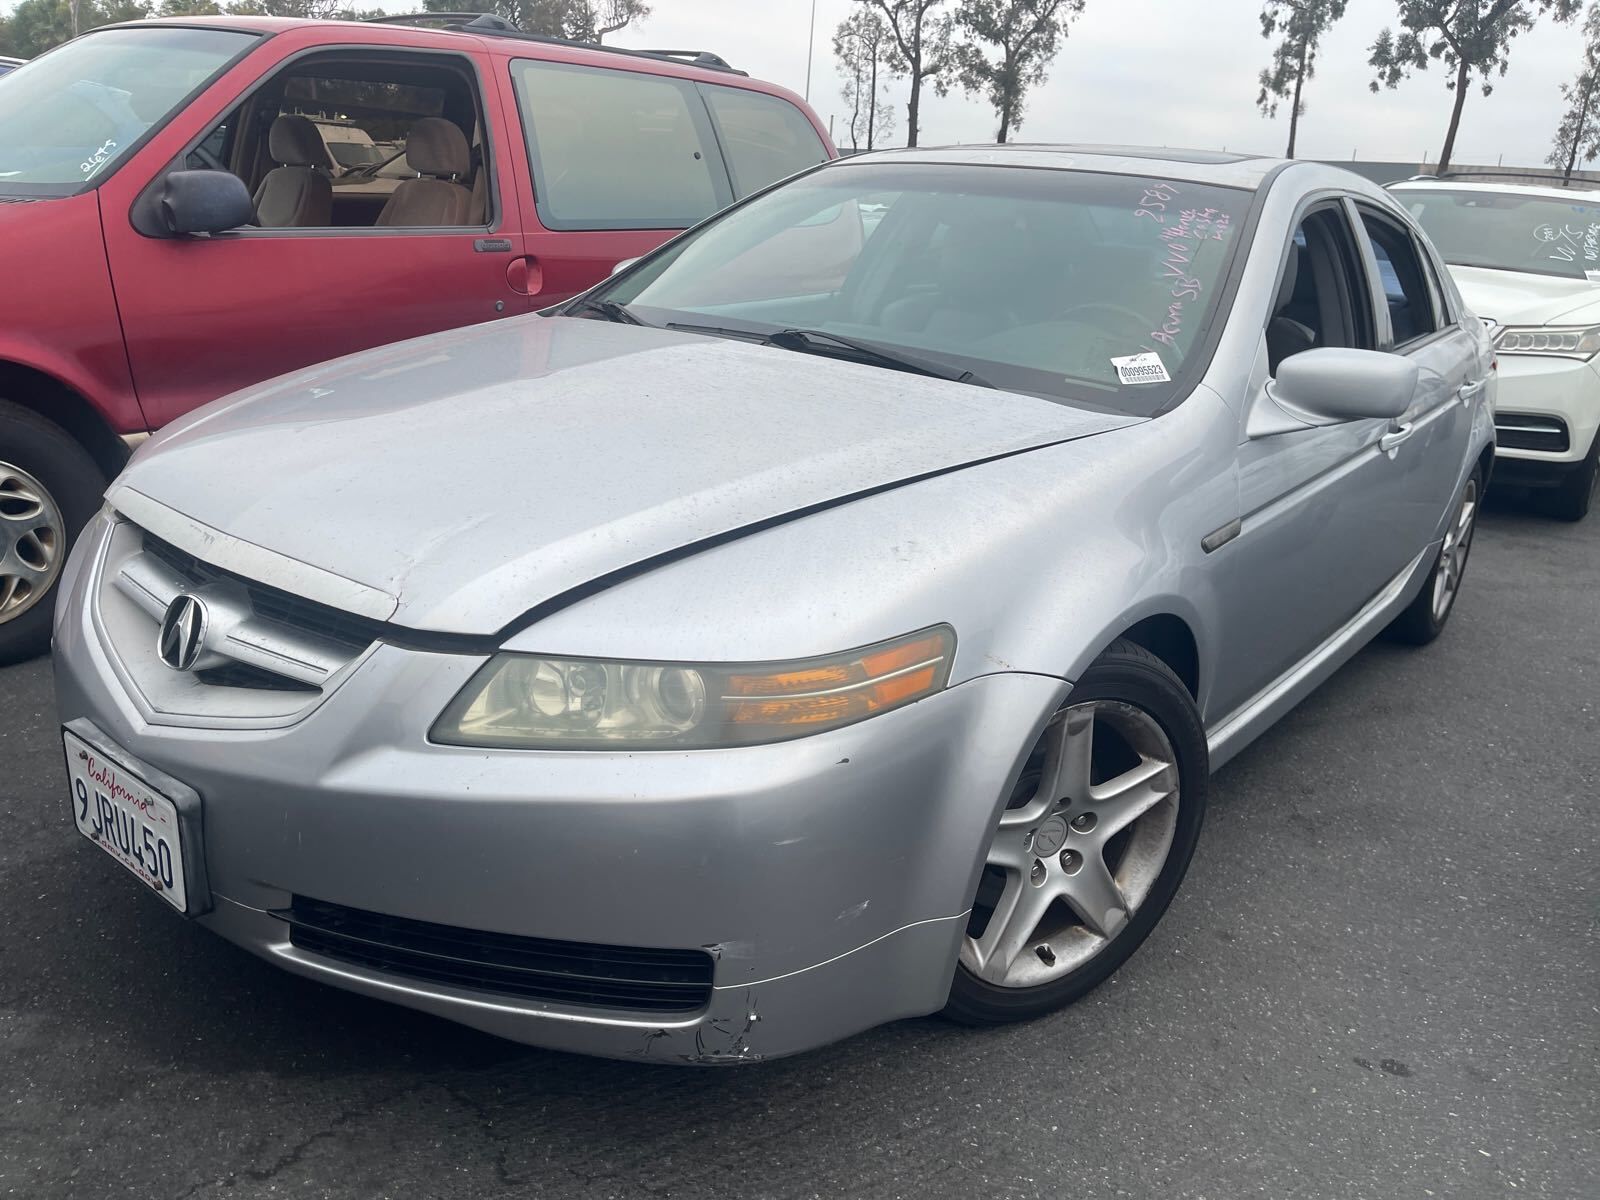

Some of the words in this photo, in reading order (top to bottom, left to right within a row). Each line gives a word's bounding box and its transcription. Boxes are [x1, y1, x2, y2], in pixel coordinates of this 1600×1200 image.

[1120, 364, 1163, 378] 000995523
[87, 757, 156, 821] California
[75, 777, 174, 889] 9JRU450
